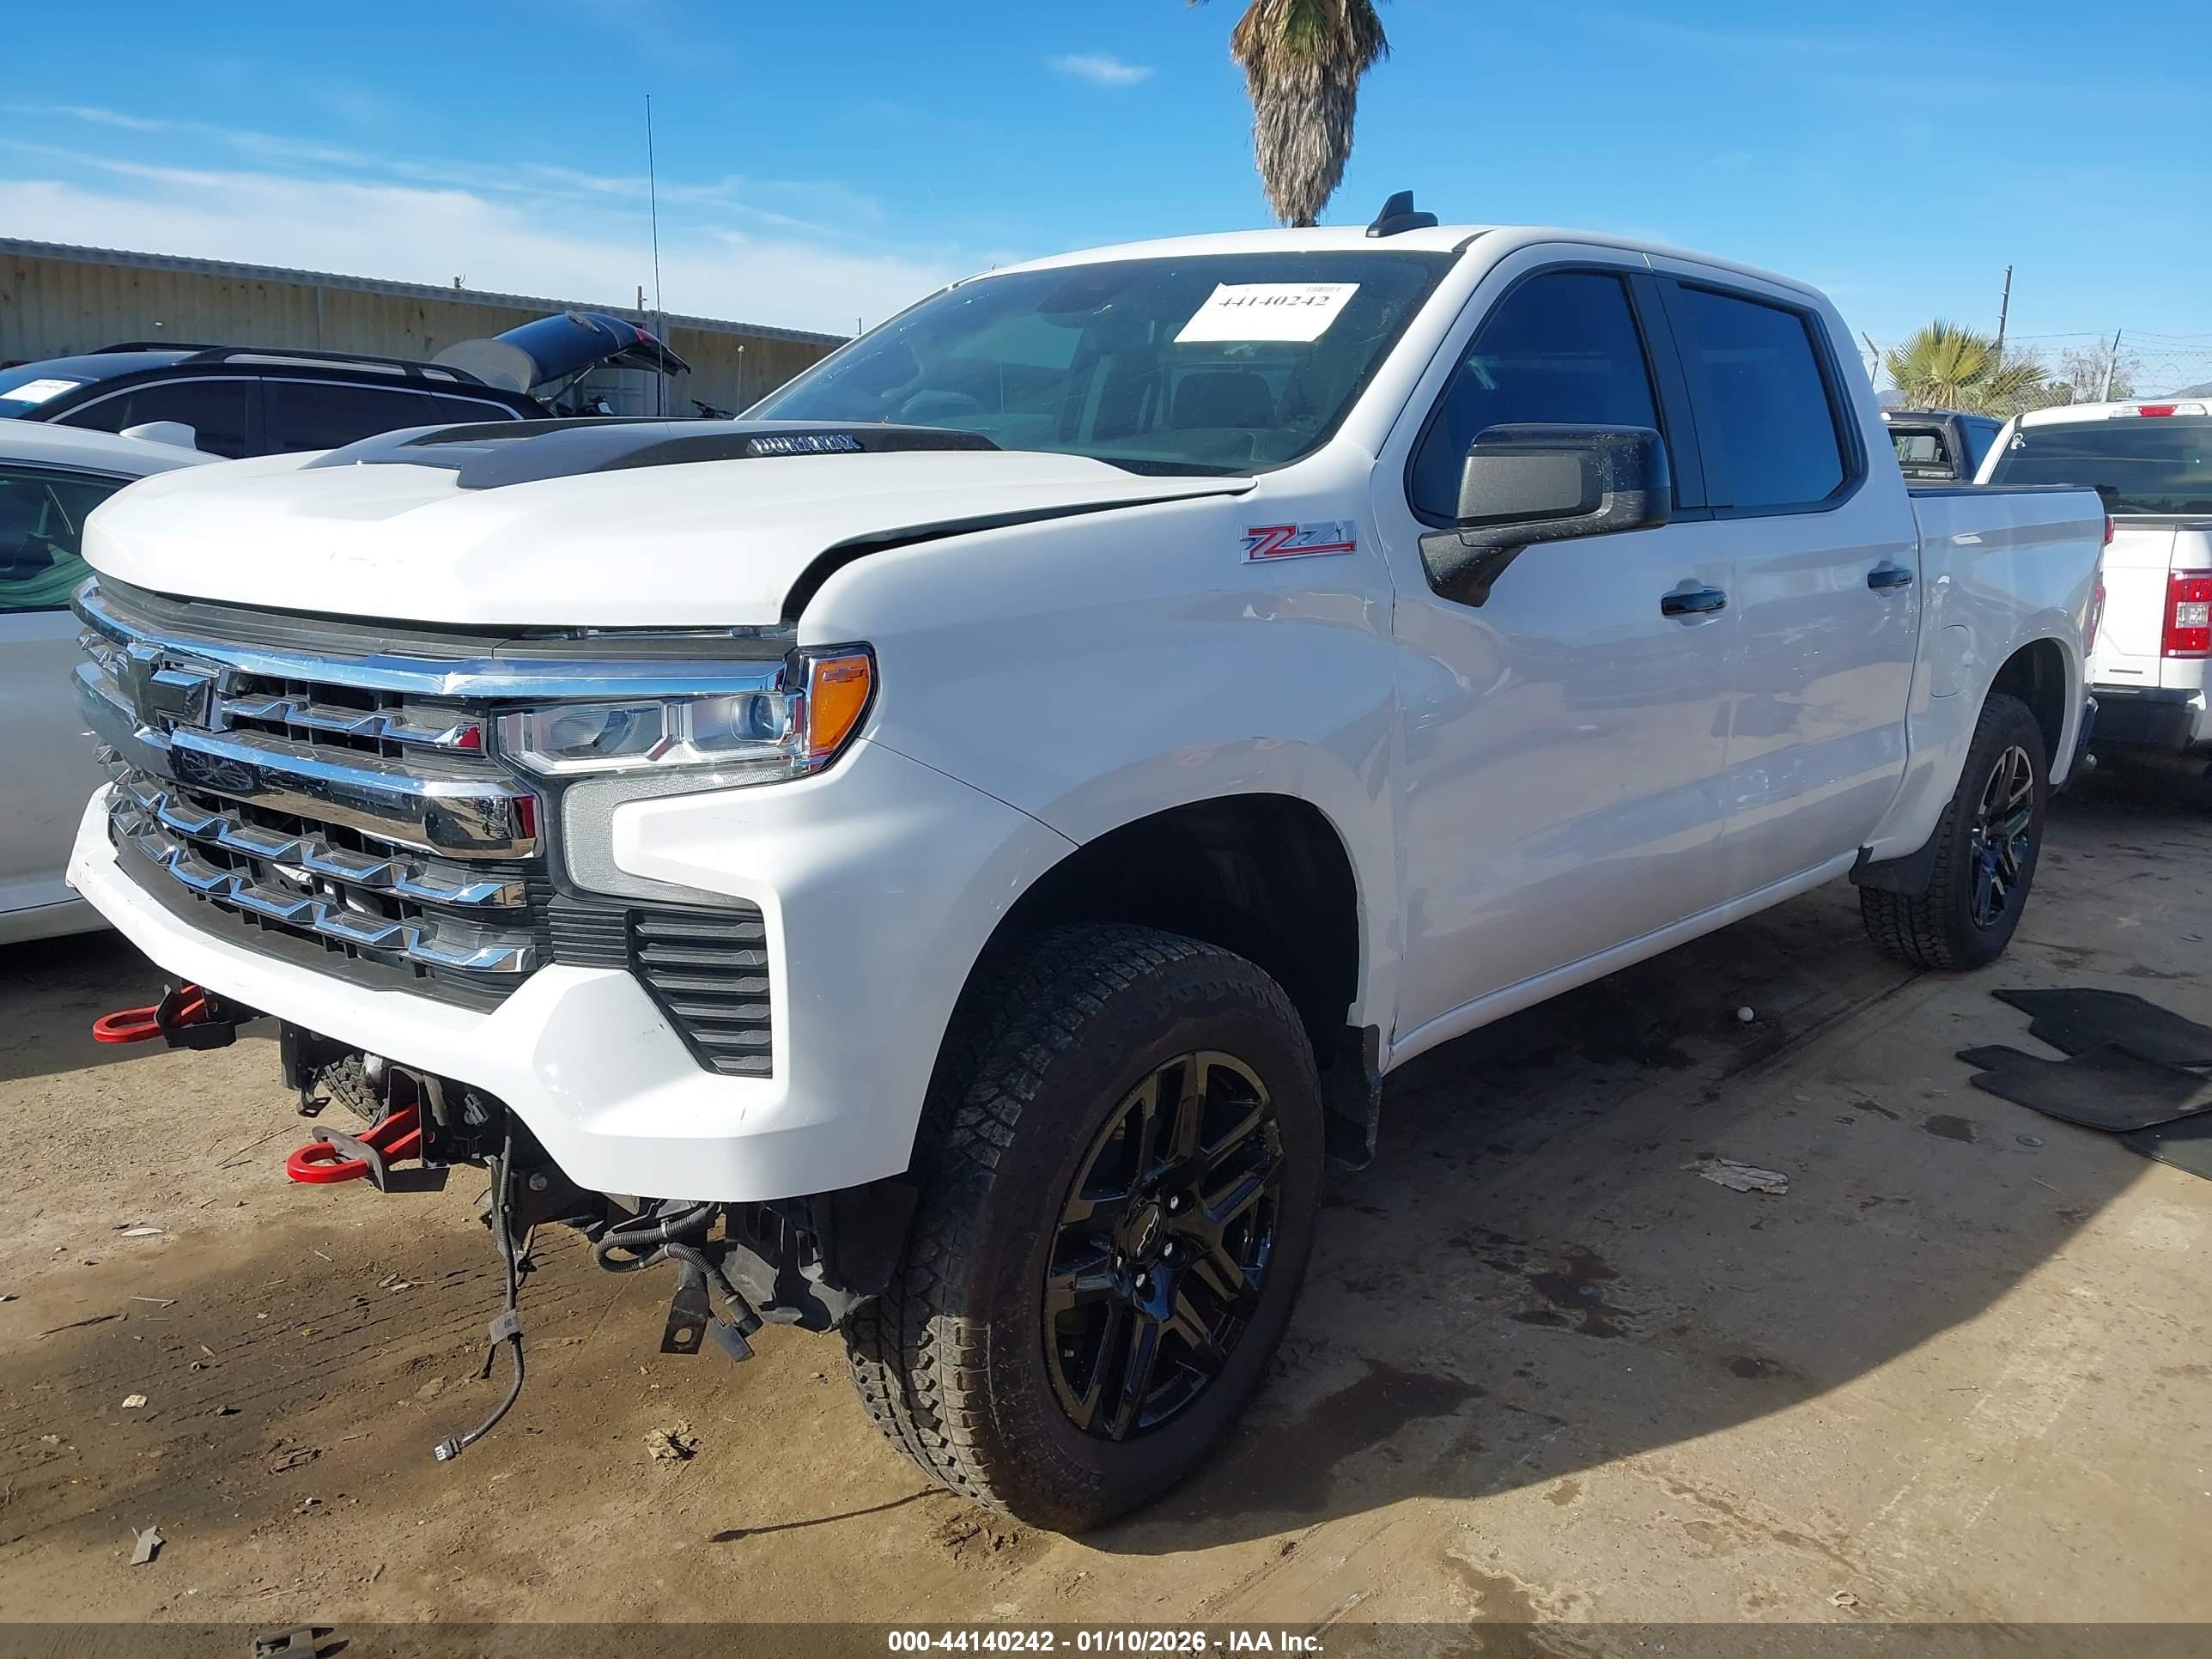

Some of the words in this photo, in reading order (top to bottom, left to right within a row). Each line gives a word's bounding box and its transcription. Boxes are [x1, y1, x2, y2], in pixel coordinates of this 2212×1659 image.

[1218, 295, 1330, 307] 44140242
[750, 434, 861, 454] DURAMAX
[1239, 520, 1358, 563] Z71
